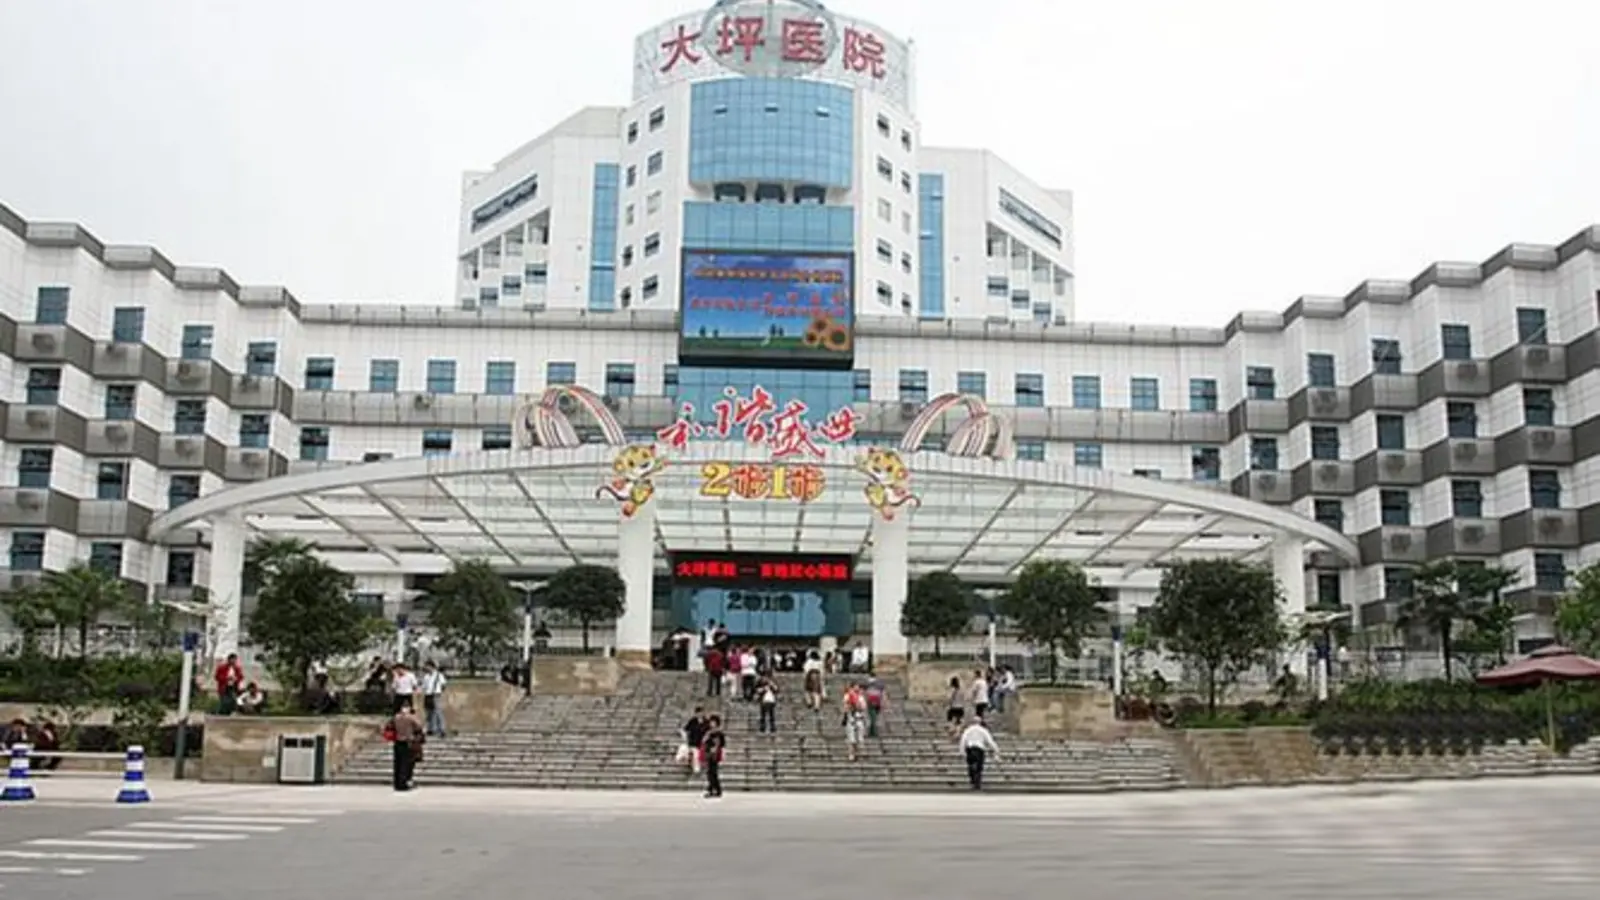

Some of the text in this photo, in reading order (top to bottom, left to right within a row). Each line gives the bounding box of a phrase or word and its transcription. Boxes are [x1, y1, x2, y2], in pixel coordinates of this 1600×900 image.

[660, 16, 886, 79] 大坪医院
[658, 386, 863, 457] 和谐盛世
[702, 463, 826, 499] 2010
